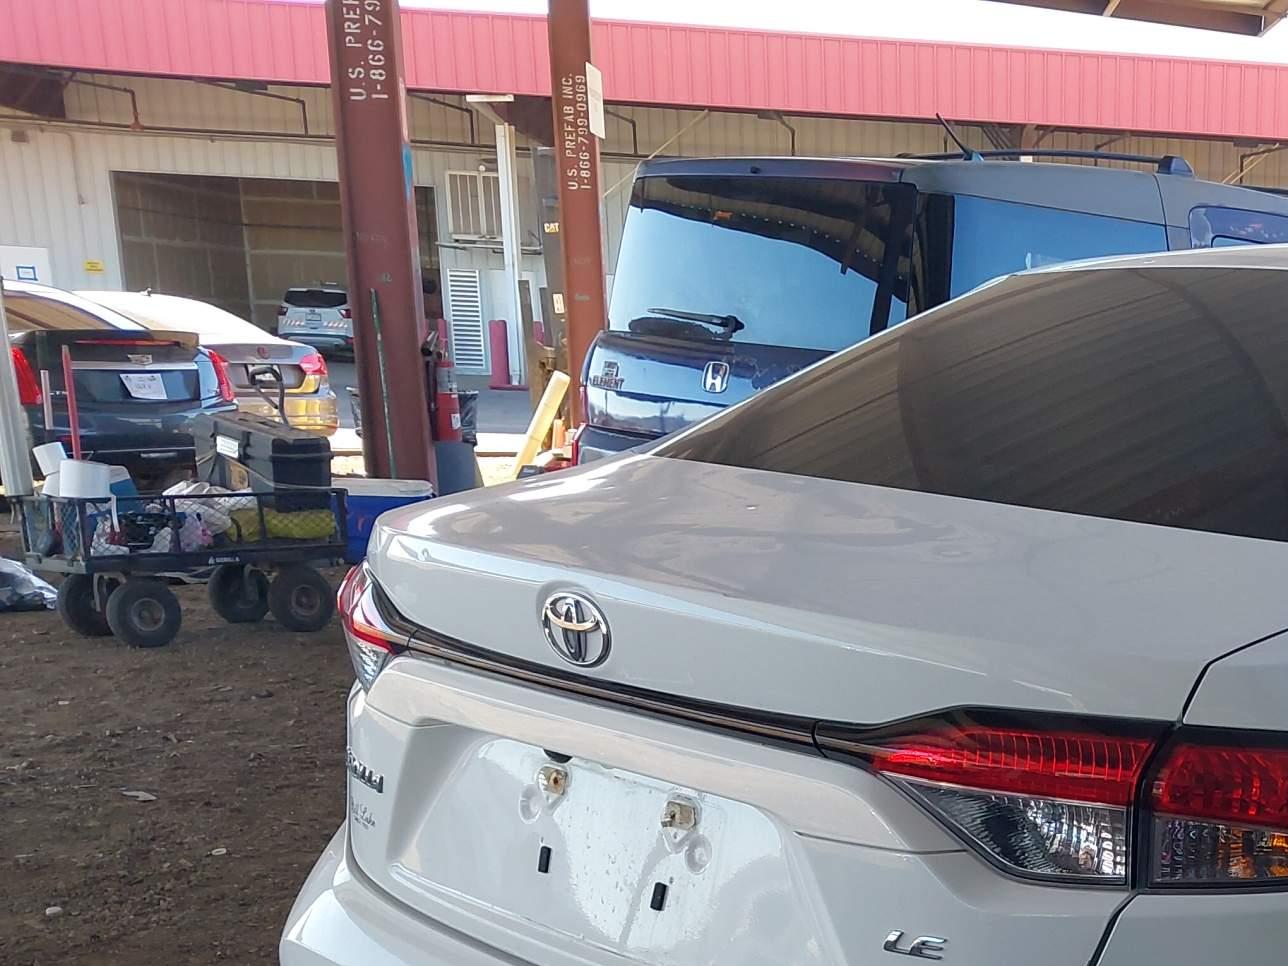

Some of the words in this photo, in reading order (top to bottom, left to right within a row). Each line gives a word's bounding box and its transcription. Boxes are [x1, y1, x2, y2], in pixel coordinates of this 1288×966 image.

[347, 60, 367, 101] U.S.
[561, 73, 573, 99] INC.
[563, 105, 577, 157] PREFAB
[575, 75, 592, 189] 1-866-799-0969
[566, 164, 579, 190] U.S.
[883, 929, 948, 960] LE
